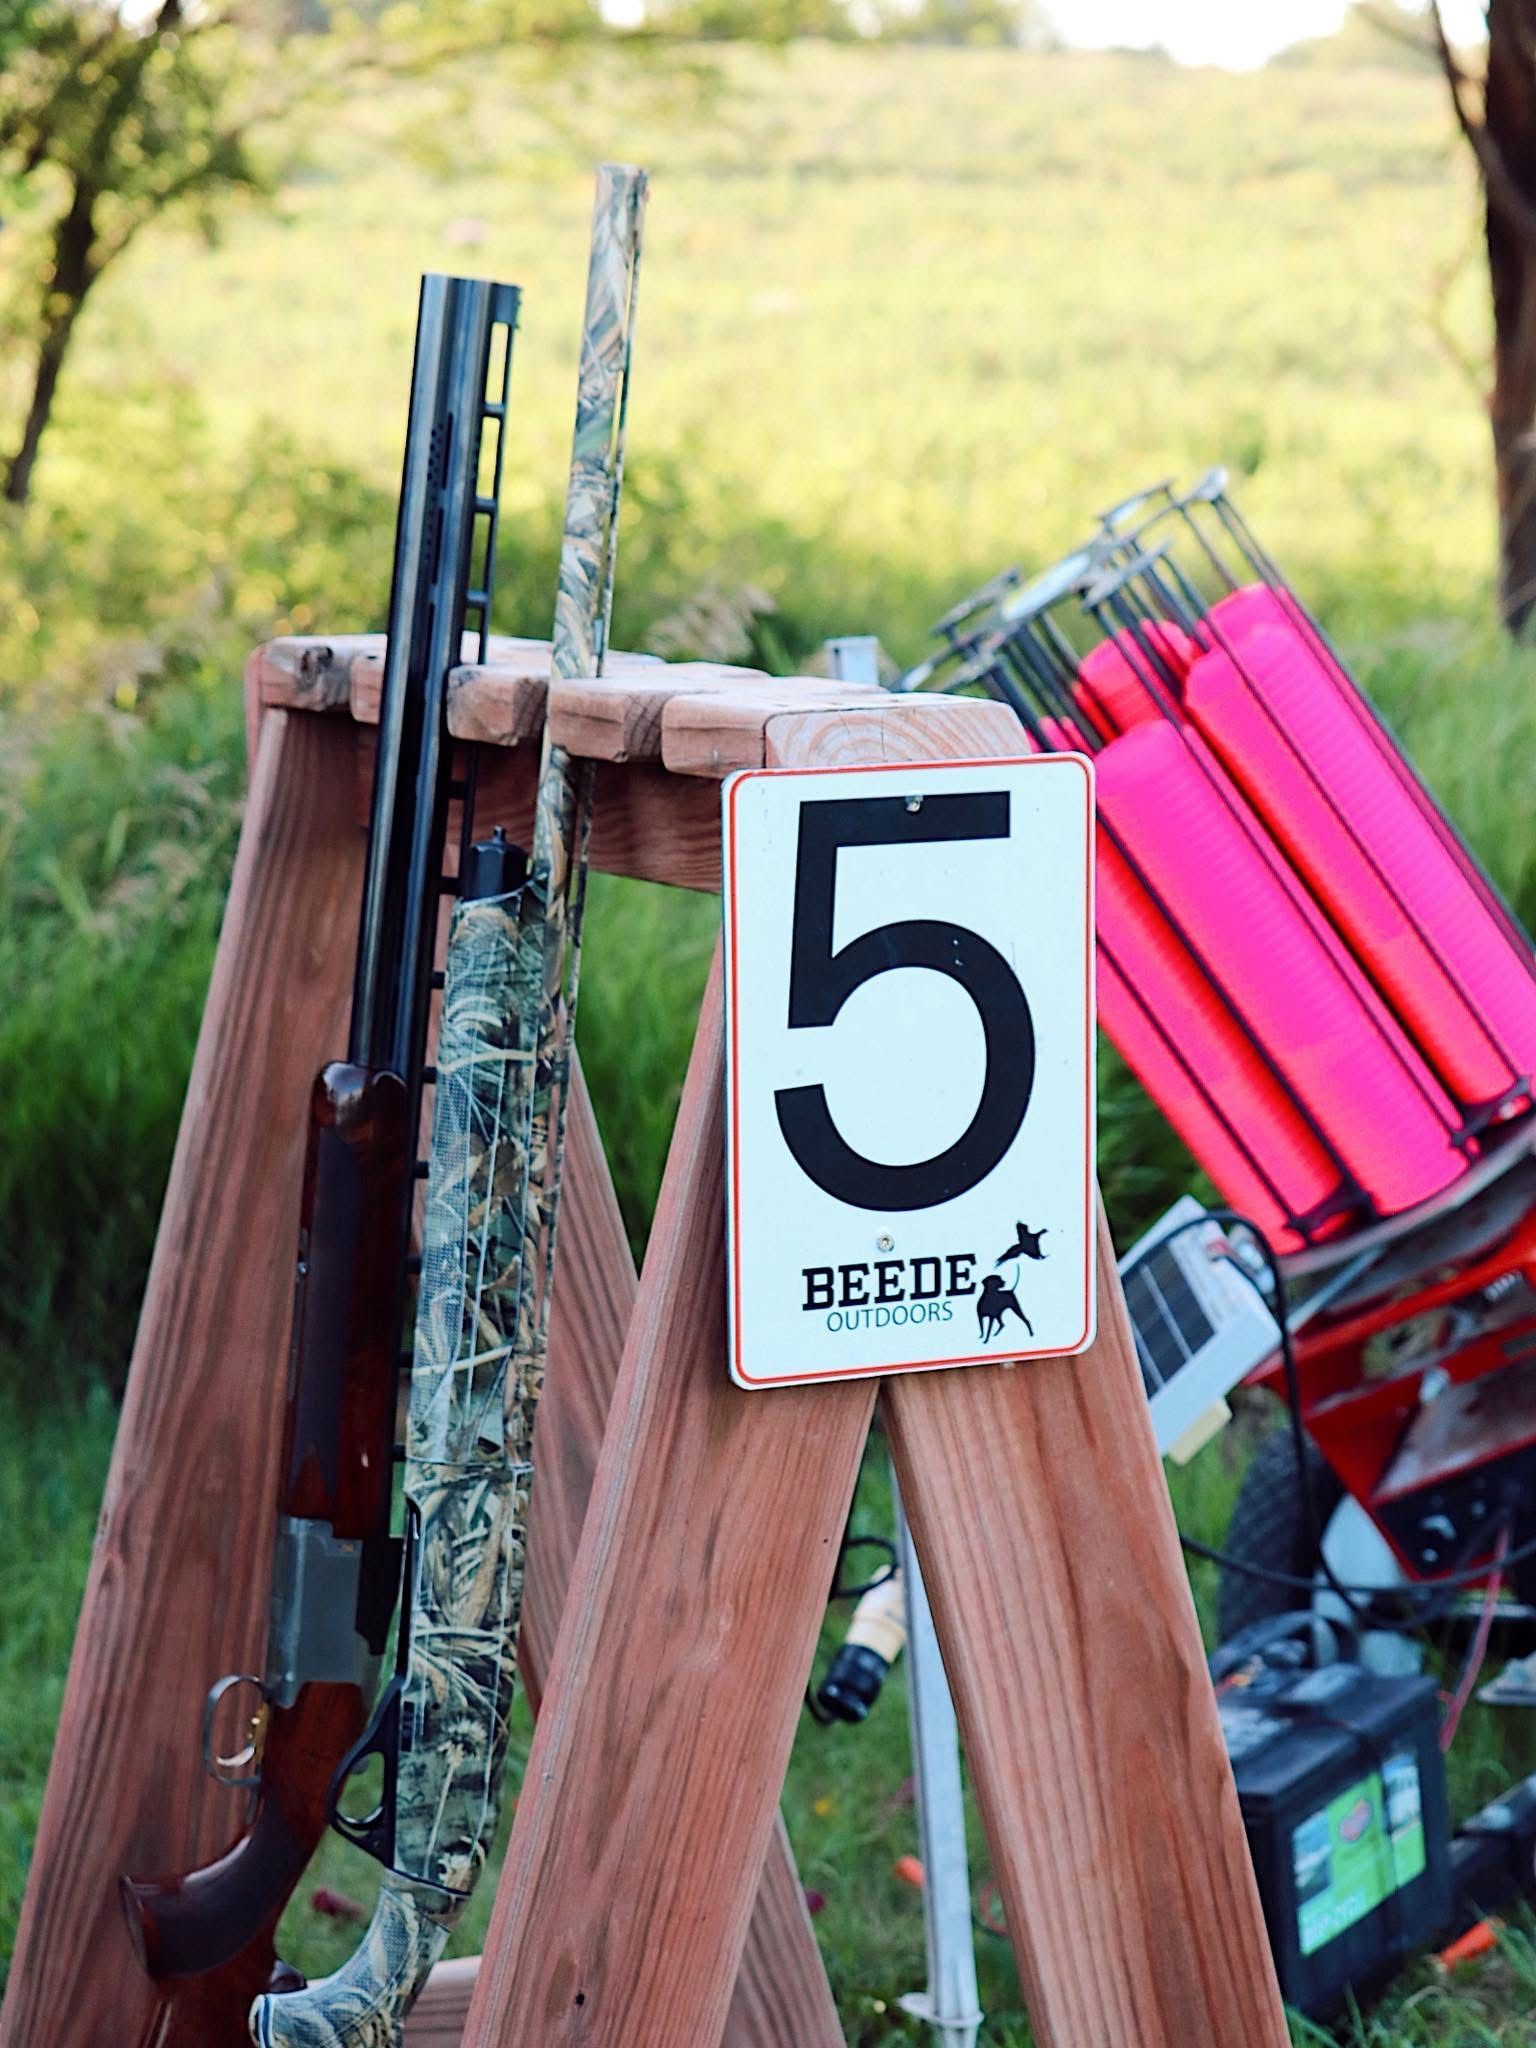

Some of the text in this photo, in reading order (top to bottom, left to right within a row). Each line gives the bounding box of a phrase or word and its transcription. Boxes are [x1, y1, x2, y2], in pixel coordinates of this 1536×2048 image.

[774, 791, 1035, 1212] 5
[802, 1253, 977, 1311] BEEDE
[827, 1301, 953, 1332] OUTDOORS
